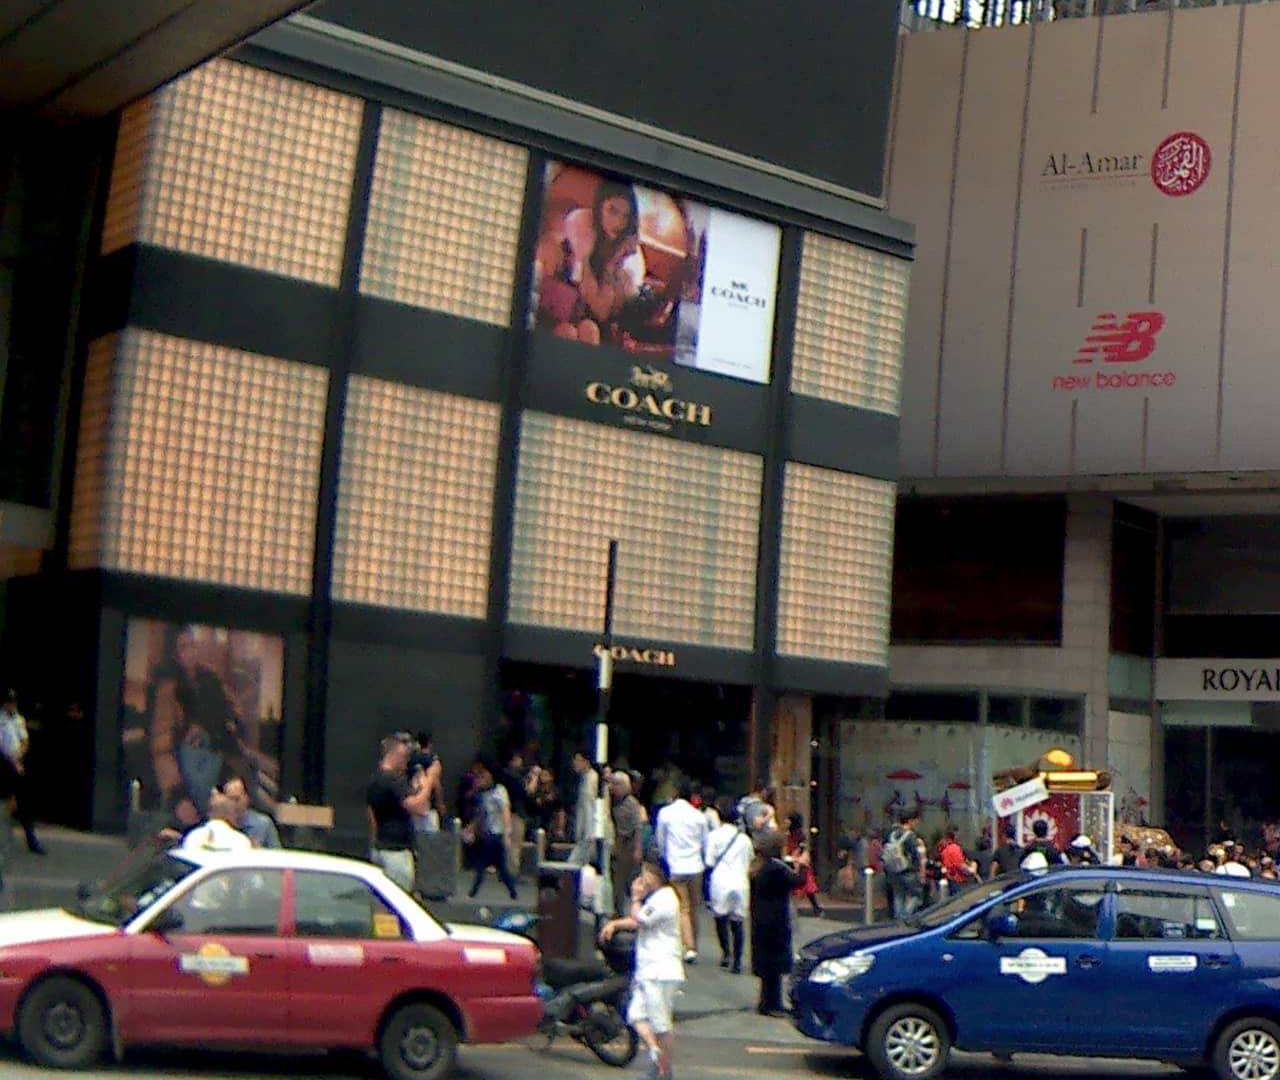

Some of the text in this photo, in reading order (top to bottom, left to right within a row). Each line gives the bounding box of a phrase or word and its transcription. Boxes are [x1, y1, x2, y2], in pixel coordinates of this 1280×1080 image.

[1042, 151, 1144, 177] Al-Amar
[710, 286, 767, 308] COACH
[1053, 370, 1177, 390] new balance
[585, 381, 712, 426] COACH
